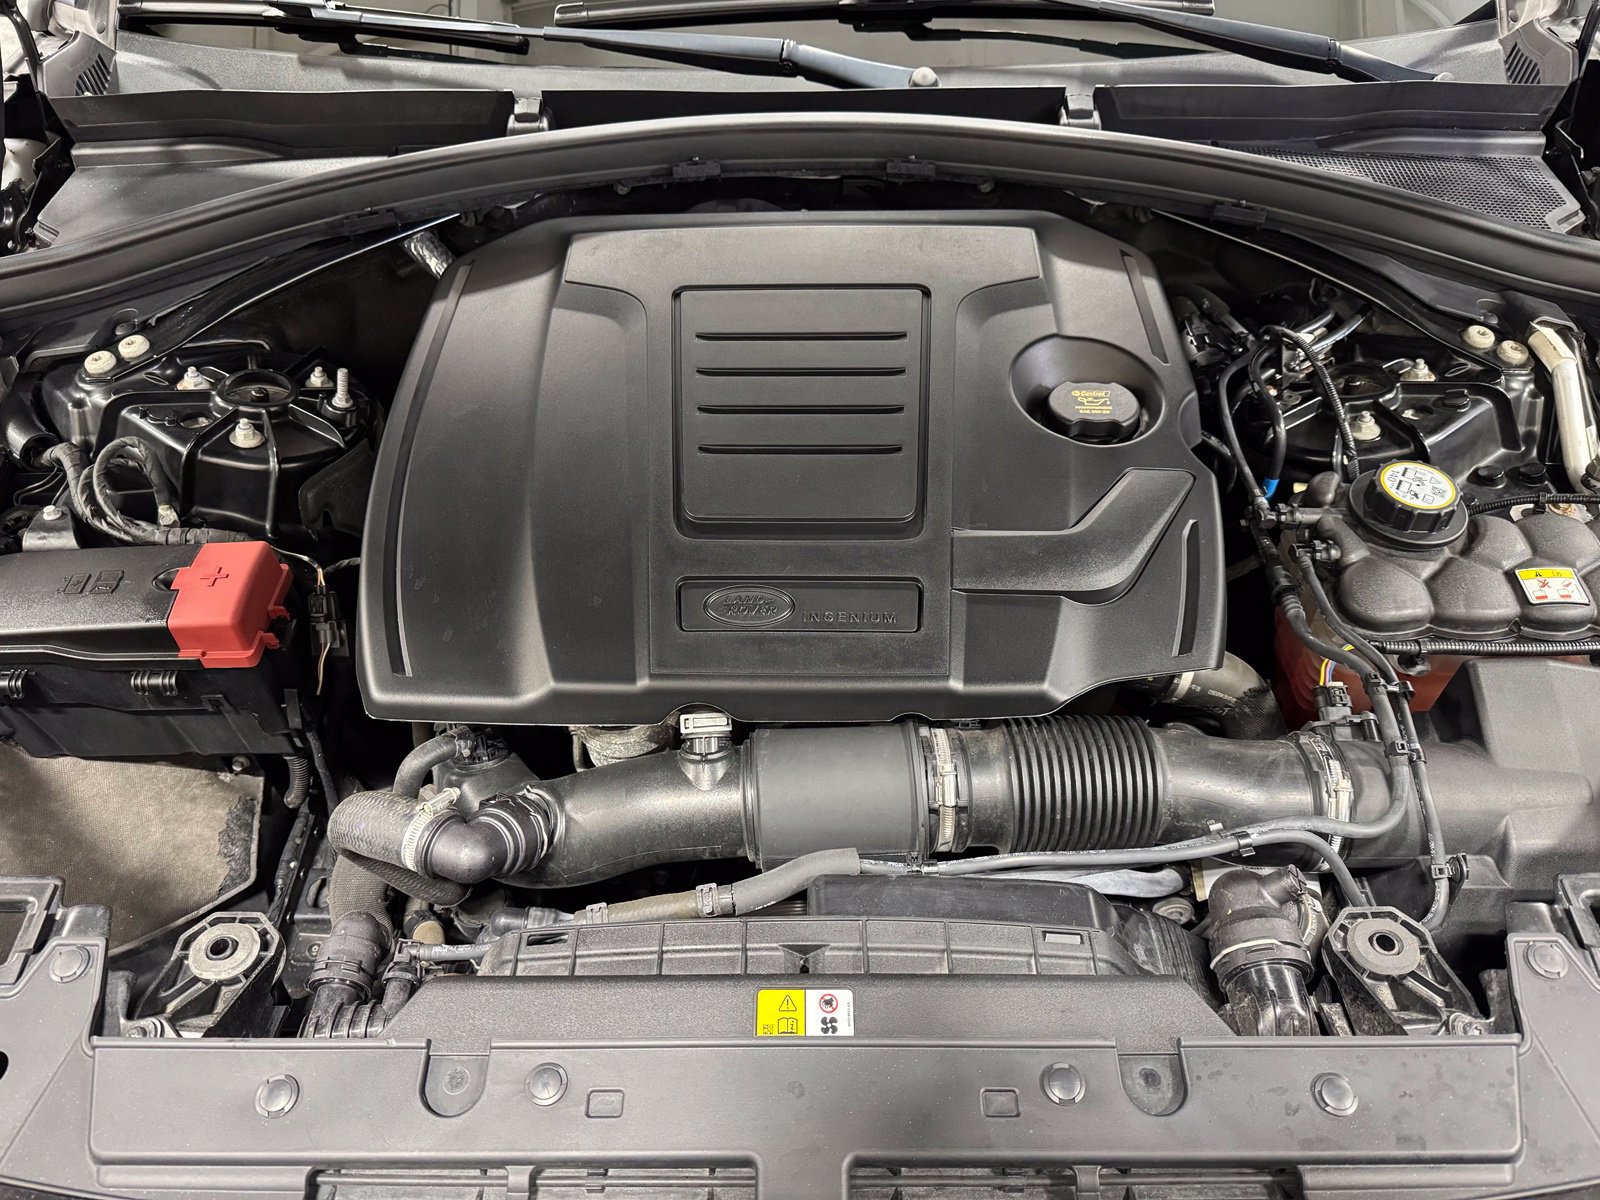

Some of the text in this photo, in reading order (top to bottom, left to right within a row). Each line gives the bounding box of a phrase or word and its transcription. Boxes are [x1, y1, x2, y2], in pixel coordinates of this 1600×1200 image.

[723, 594, 765, 605] LAND
[726, 604, 778, 616] ROVER
[803, 611, 898, 624] INGENIUM
